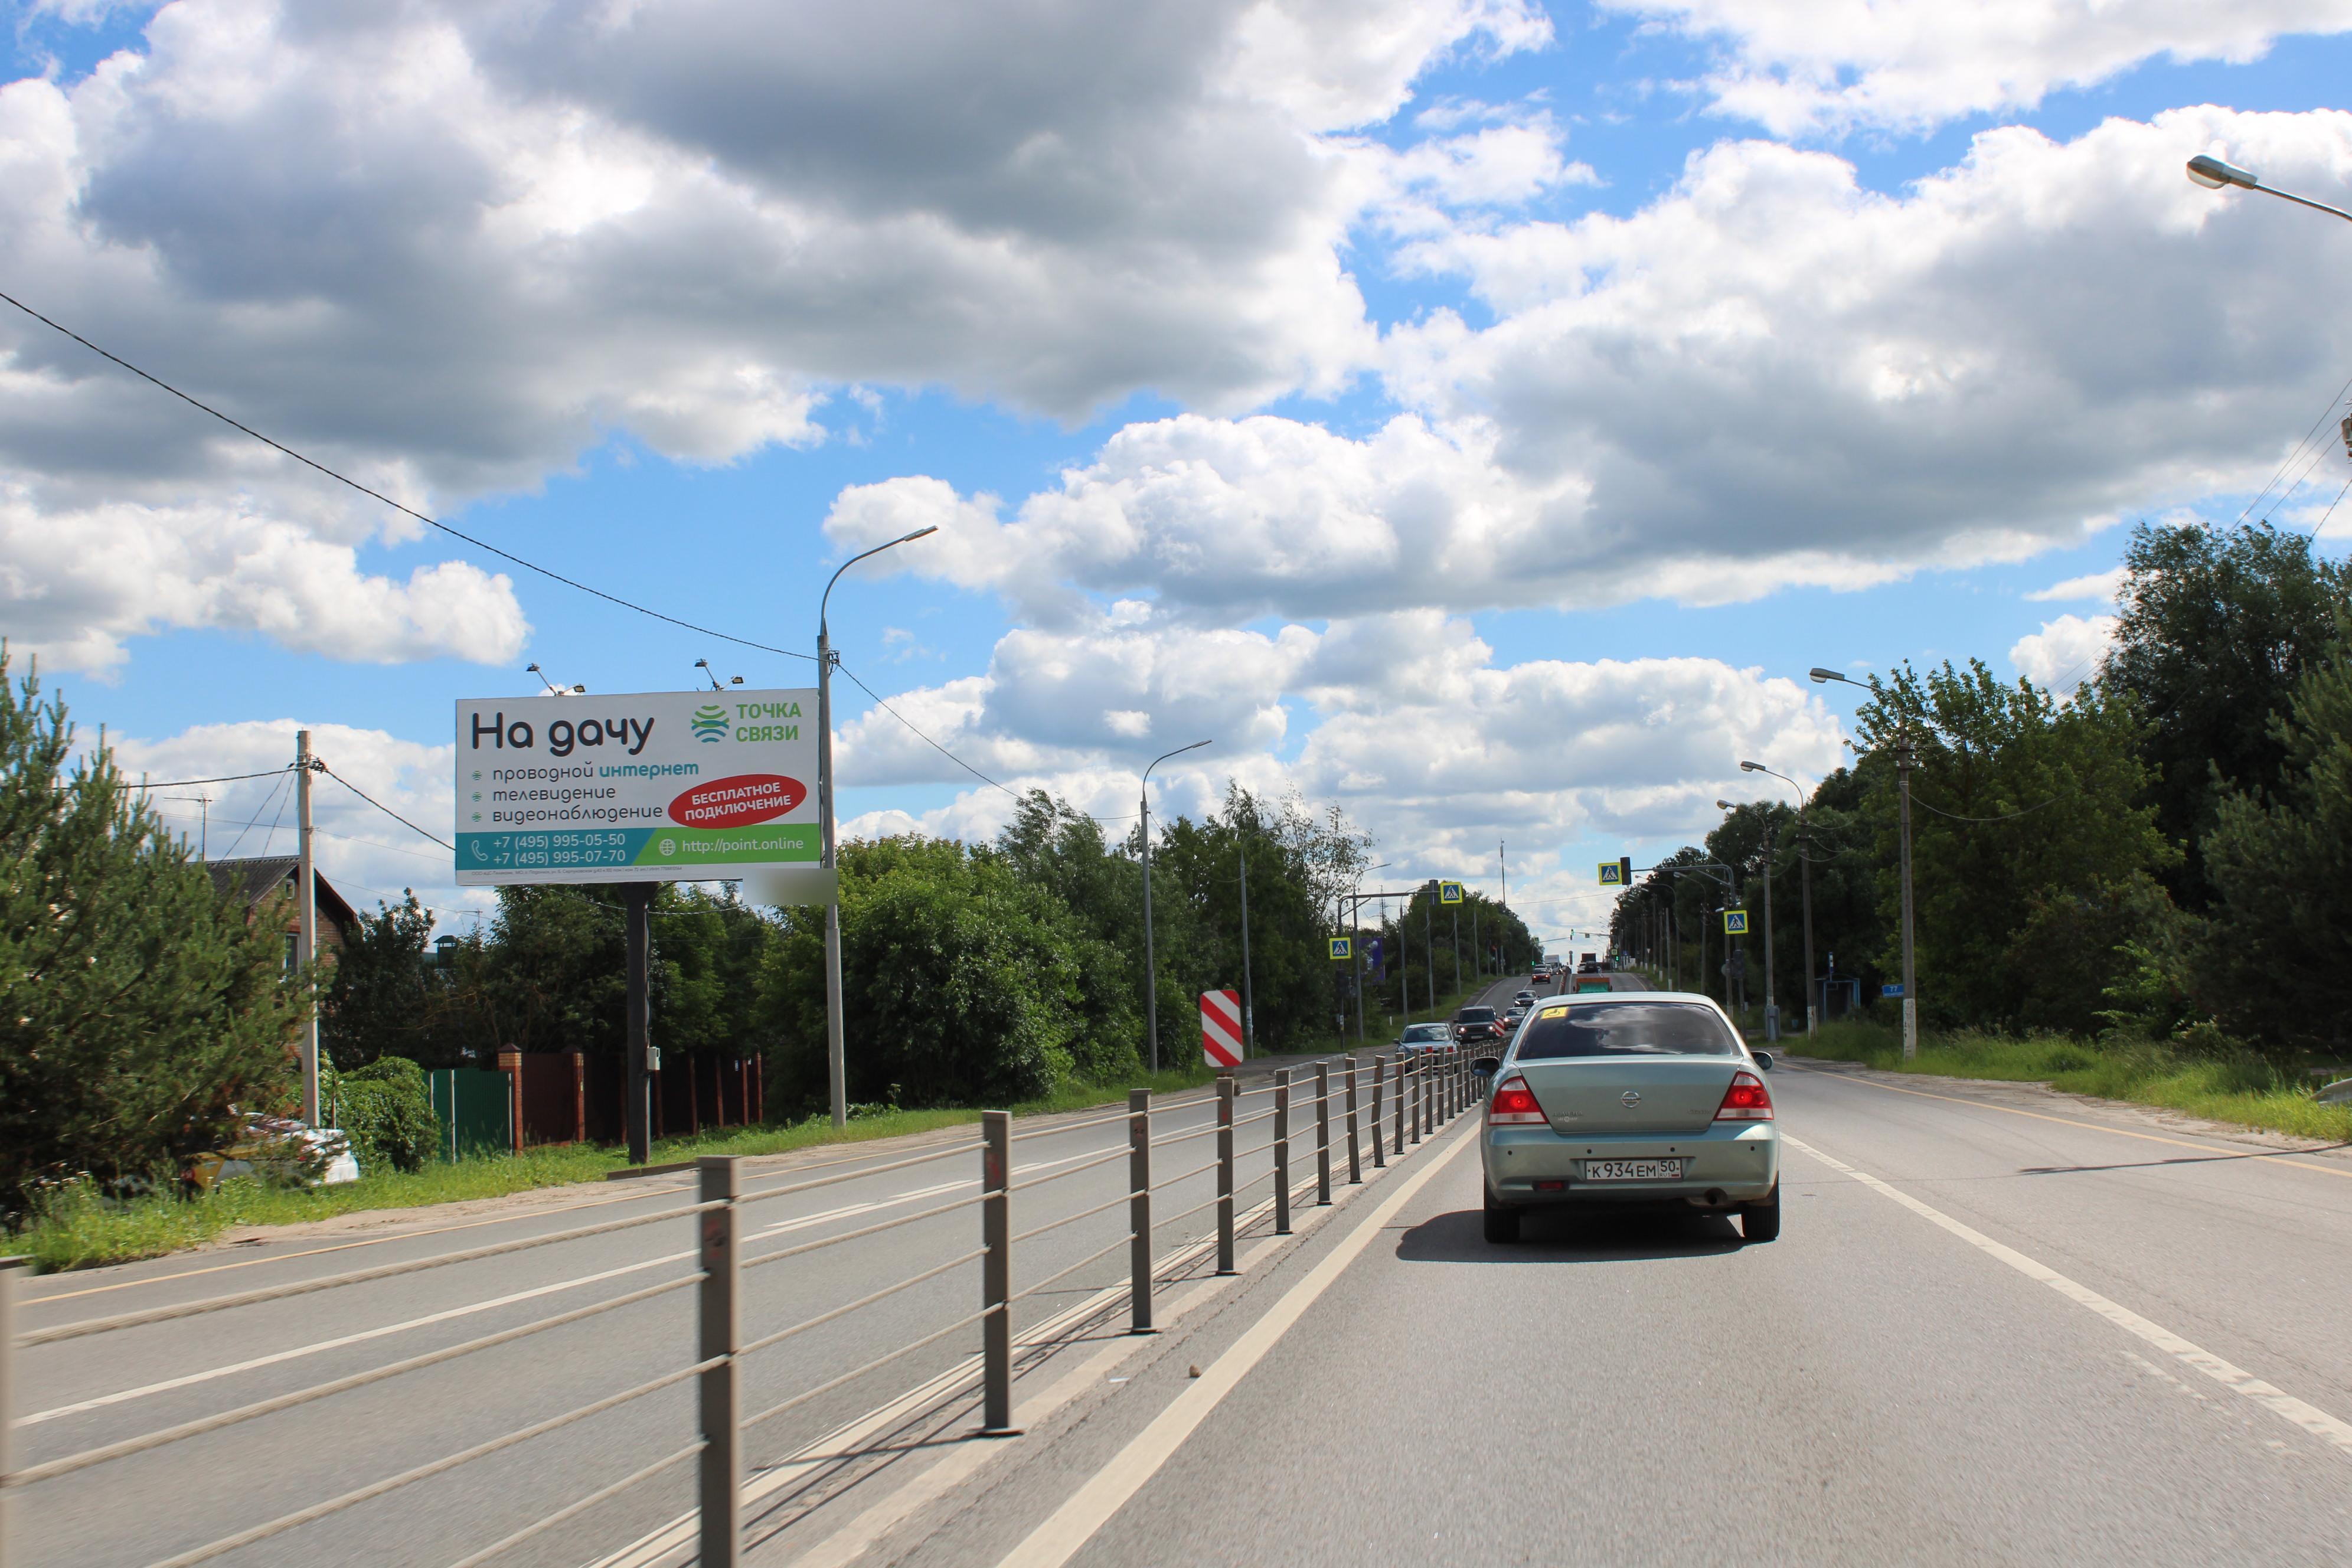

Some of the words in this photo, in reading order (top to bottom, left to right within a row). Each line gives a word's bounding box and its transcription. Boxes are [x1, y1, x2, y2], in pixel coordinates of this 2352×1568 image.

[736, 702, 802, 720] ТОЧКА
[472, 712, 534, 750] На
[548, 717, 655, 757] дачу
[736, 725, 799, 742] СВЯЗИ
[493, 761, 594, 783] проводной
[599, 763, 700, 780] интернет
[493, 788, 616, 803] телевидение
[691, 782, 781, 806] БЕСПЛАТНОЕ
[493, 805, 663, 825] видеонаблюдение
[685, 795, 792, 821] ПОДКЛЮЧЕНИЕ
[493, 837, 511, 848] +7
[515, 835, 548, 850] (495)
[553, 833, 626, 847] 995-05-50
[682, 837, 804, 854] http://point.online
[493, 852, 511, 864] +7
[515, 852, 548, 867] (495)
[553, 850, 626, 863] 995-07-70
[1660, 1161, 1675, 1172] 50
